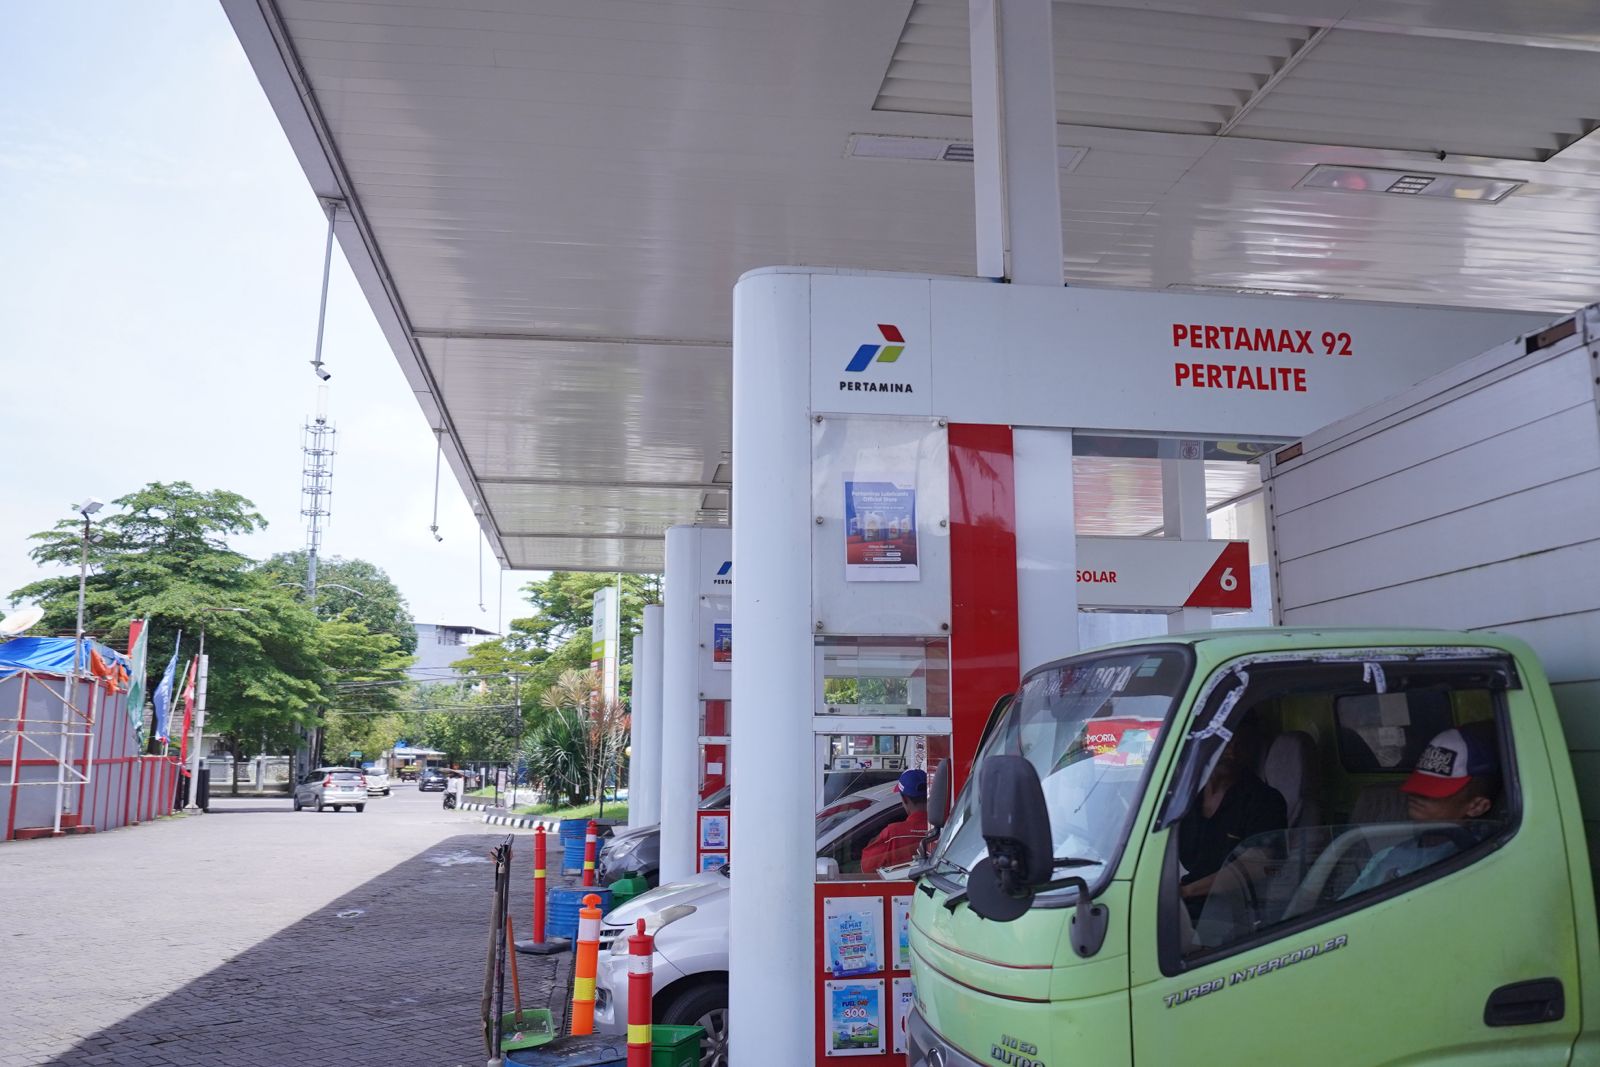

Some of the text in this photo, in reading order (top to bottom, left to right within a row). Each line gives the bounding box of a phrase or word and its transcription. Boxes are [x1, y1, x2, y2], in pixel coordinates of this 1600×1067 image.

[1172, 323, 1353, 356] PERTAMAX 92
[839, 381, 913, 393] PERTAMINA
[1174, 363, 1307, 392] PERTALITE
[1076, 570, 1117, 583] SOLAR
[1219, 567, 1238, 592] 6
[1163, 935, 1348, 1009] TURBO INTERCOOLER
